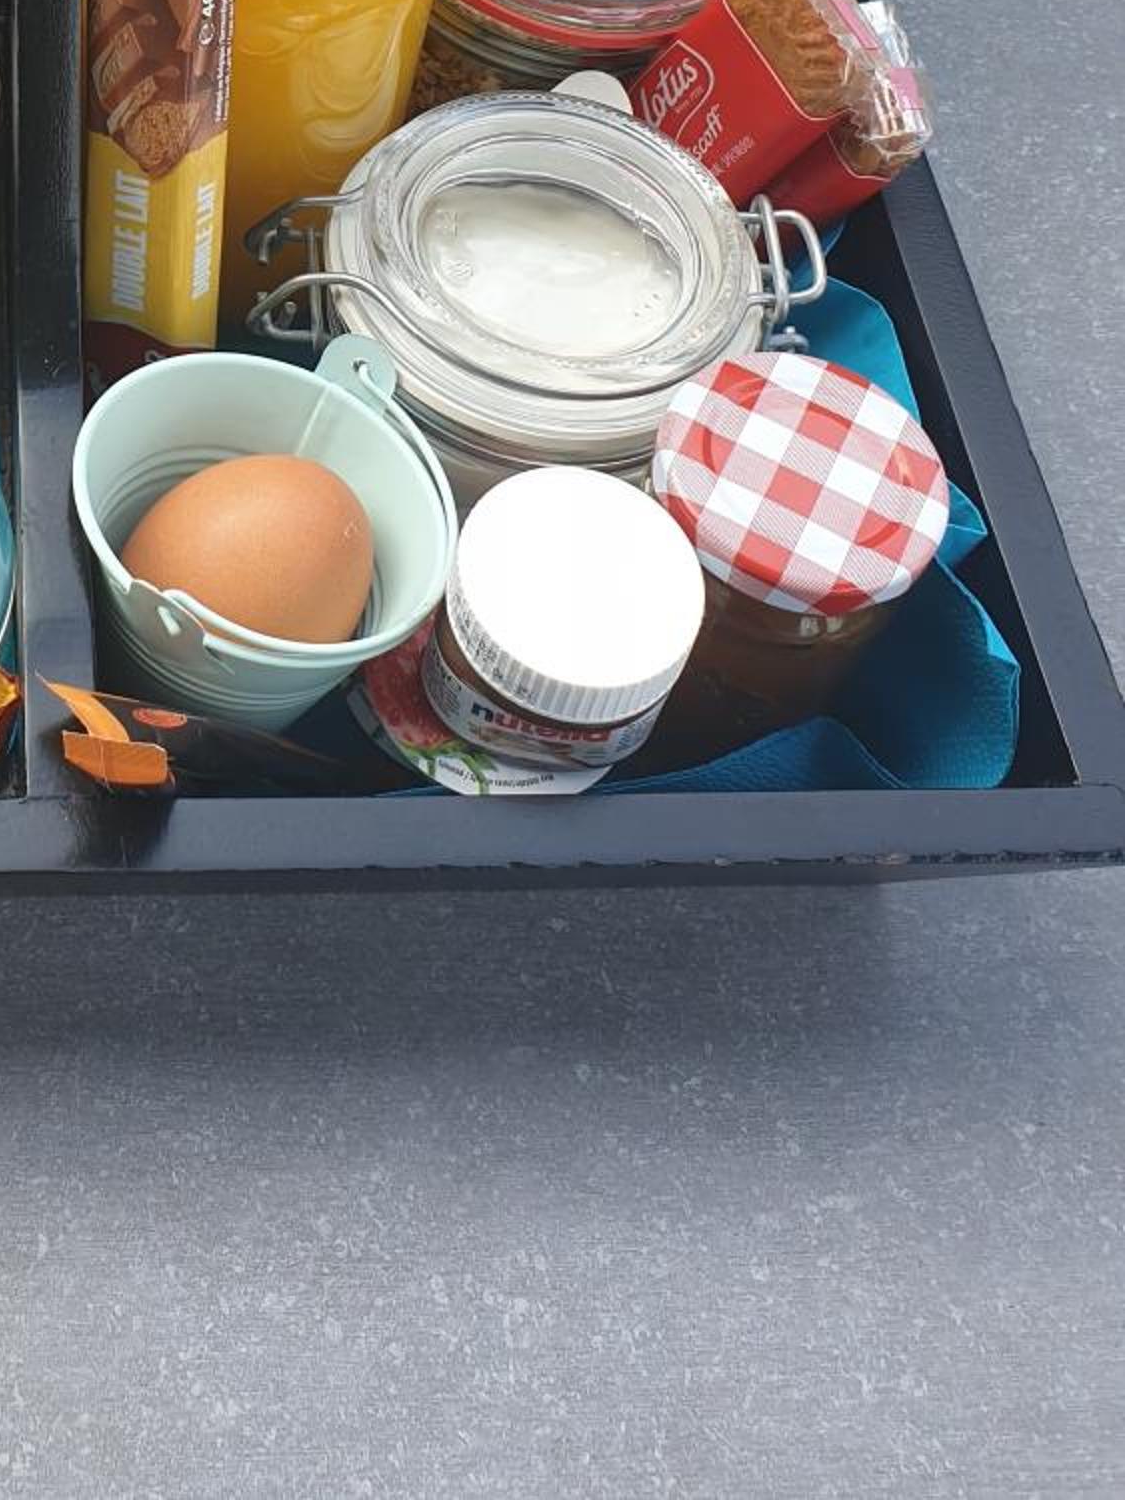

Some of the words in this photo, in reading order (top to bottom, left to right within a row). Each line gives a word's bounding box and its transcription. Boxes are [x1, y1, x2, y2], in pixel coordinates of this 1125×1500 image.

[689, 103, 723, 161] scoff
[114, 169, 150, 223] LAIT
[111, 225, 147, 311] DOUBLE
